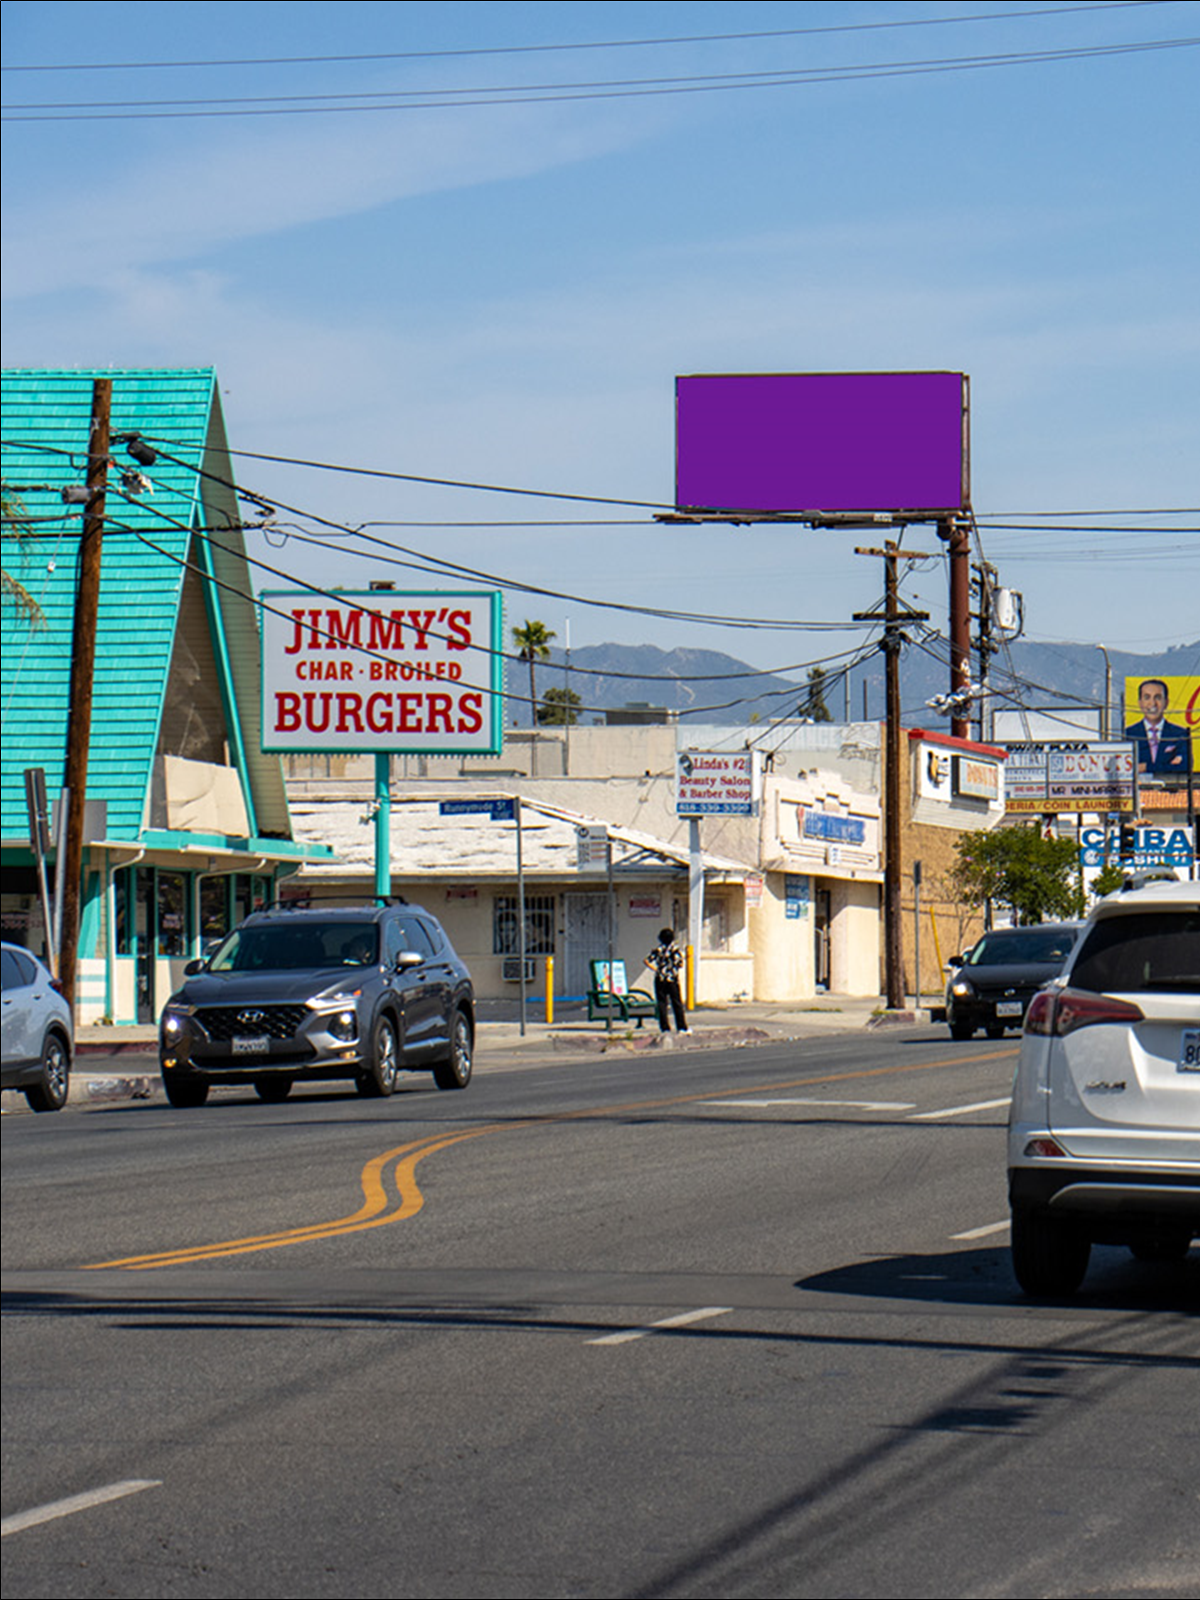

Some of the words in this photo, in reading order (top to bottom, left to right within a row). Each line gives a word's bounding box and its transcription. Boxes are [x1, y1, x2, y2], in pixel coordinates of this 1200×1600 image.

[284, 608, 473, 655] JIMMY'S
[296, 661, 353, 681] CHAR
[369, 661, 463, 682] BROILED
[274, 691, 484, 734] BURGERS
[1049, 744, 1089, 752] PLAZA
[693, 757, 729, 770] Linda's
[1065, 754, 1133, 773] DONUTS
[679, 775, 717, 788] Beauty
[720, 775, 751, 786] Salon
[690, 788, 723, 799] Barber
[725, 788, 751, 801] Shop
[1075, 801, 1129, 811] LAUNDRY
